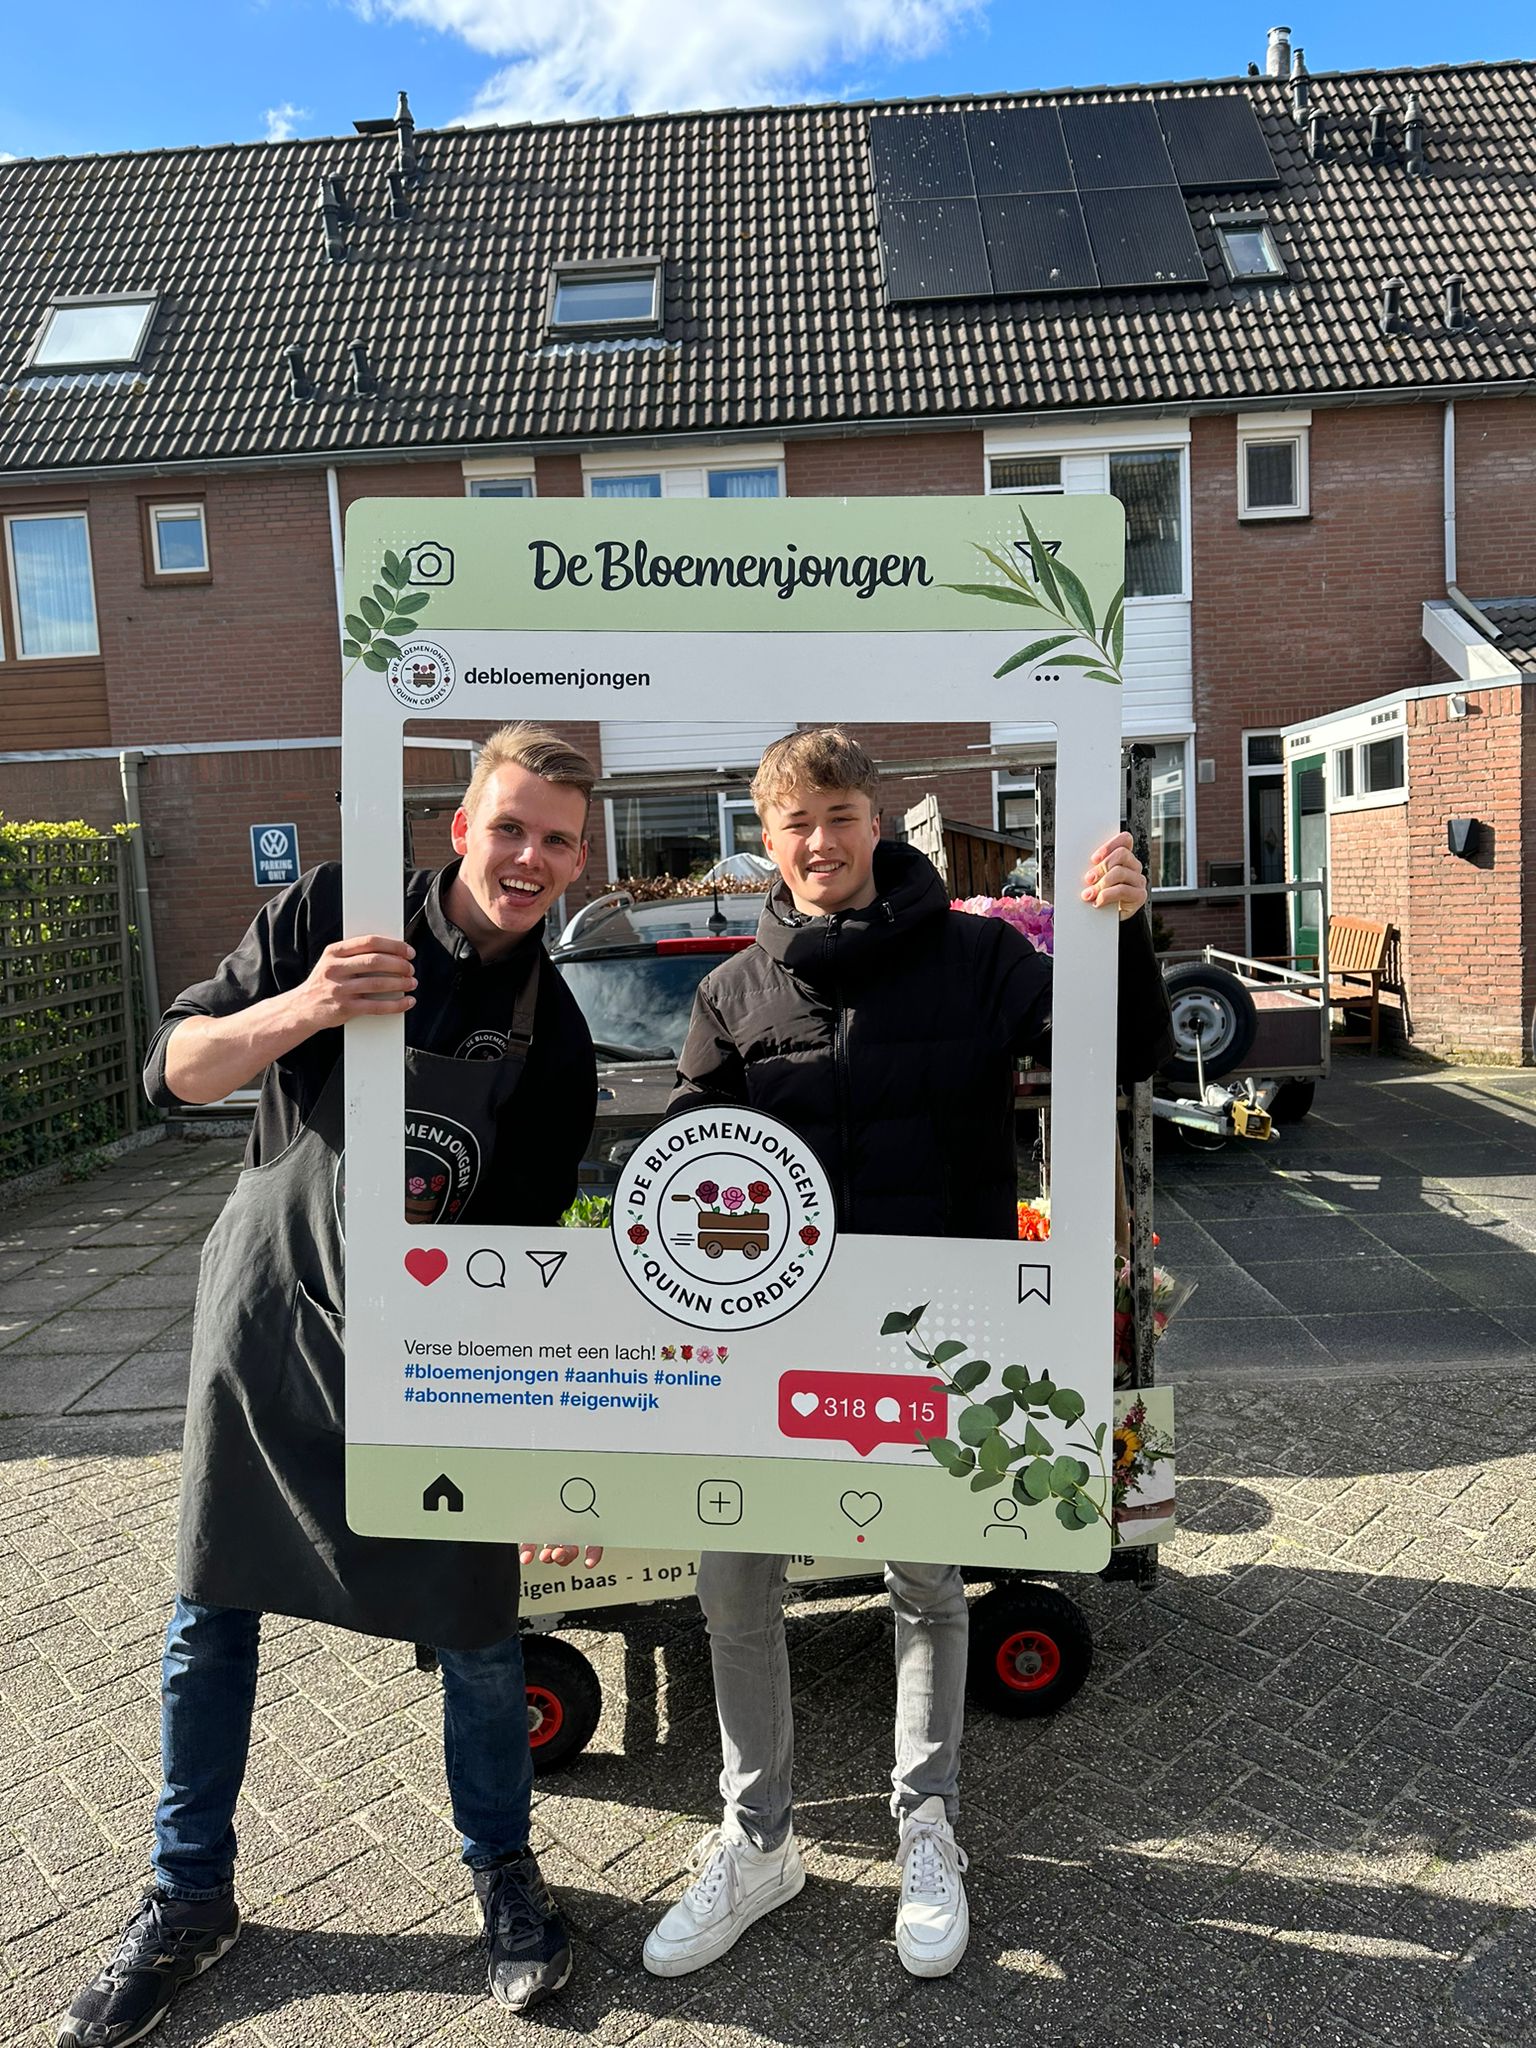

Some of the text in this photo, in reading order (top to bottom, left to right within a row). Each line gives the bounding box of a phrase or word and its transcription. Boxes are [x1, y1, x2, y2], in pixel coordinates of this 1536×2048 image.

[528, 539, 935, 599] De Bloemenjongen
[392, 662, 400, 672] DE
[464, 667, 650, 690] debloemenjongen
[396, 687, 446, 705] QUINN CORDES
[260, 859, 293, 871] PARKING
[268, 870, 286, 880] ONLY
[405, 1122, 471, 1189] MENJONGEN
[629, 1122, 819, 1209] DE BLOEMENJONGEN
[643, 1260, 805, 1315] QUINN CORDES
[404, 1340, 656, 1361] Verse bloemen met een lach!
[404, 1363, 722, 1387] #bloemenjongen #aanhuis #online
[404, 1387, 660, 1411] #abonnementen #eigenwijk
[824, 1397, 866, 1418] 318
[908, 1401, 935, 1422] 15
[519, 1580, 565, 1600] igen
[571, 1574, 617, 1591] baas
[642, 1567, 653, 1582] 1
[657, 1565, 682, 1582] op
[687, 1562, 697, 1576] 1
